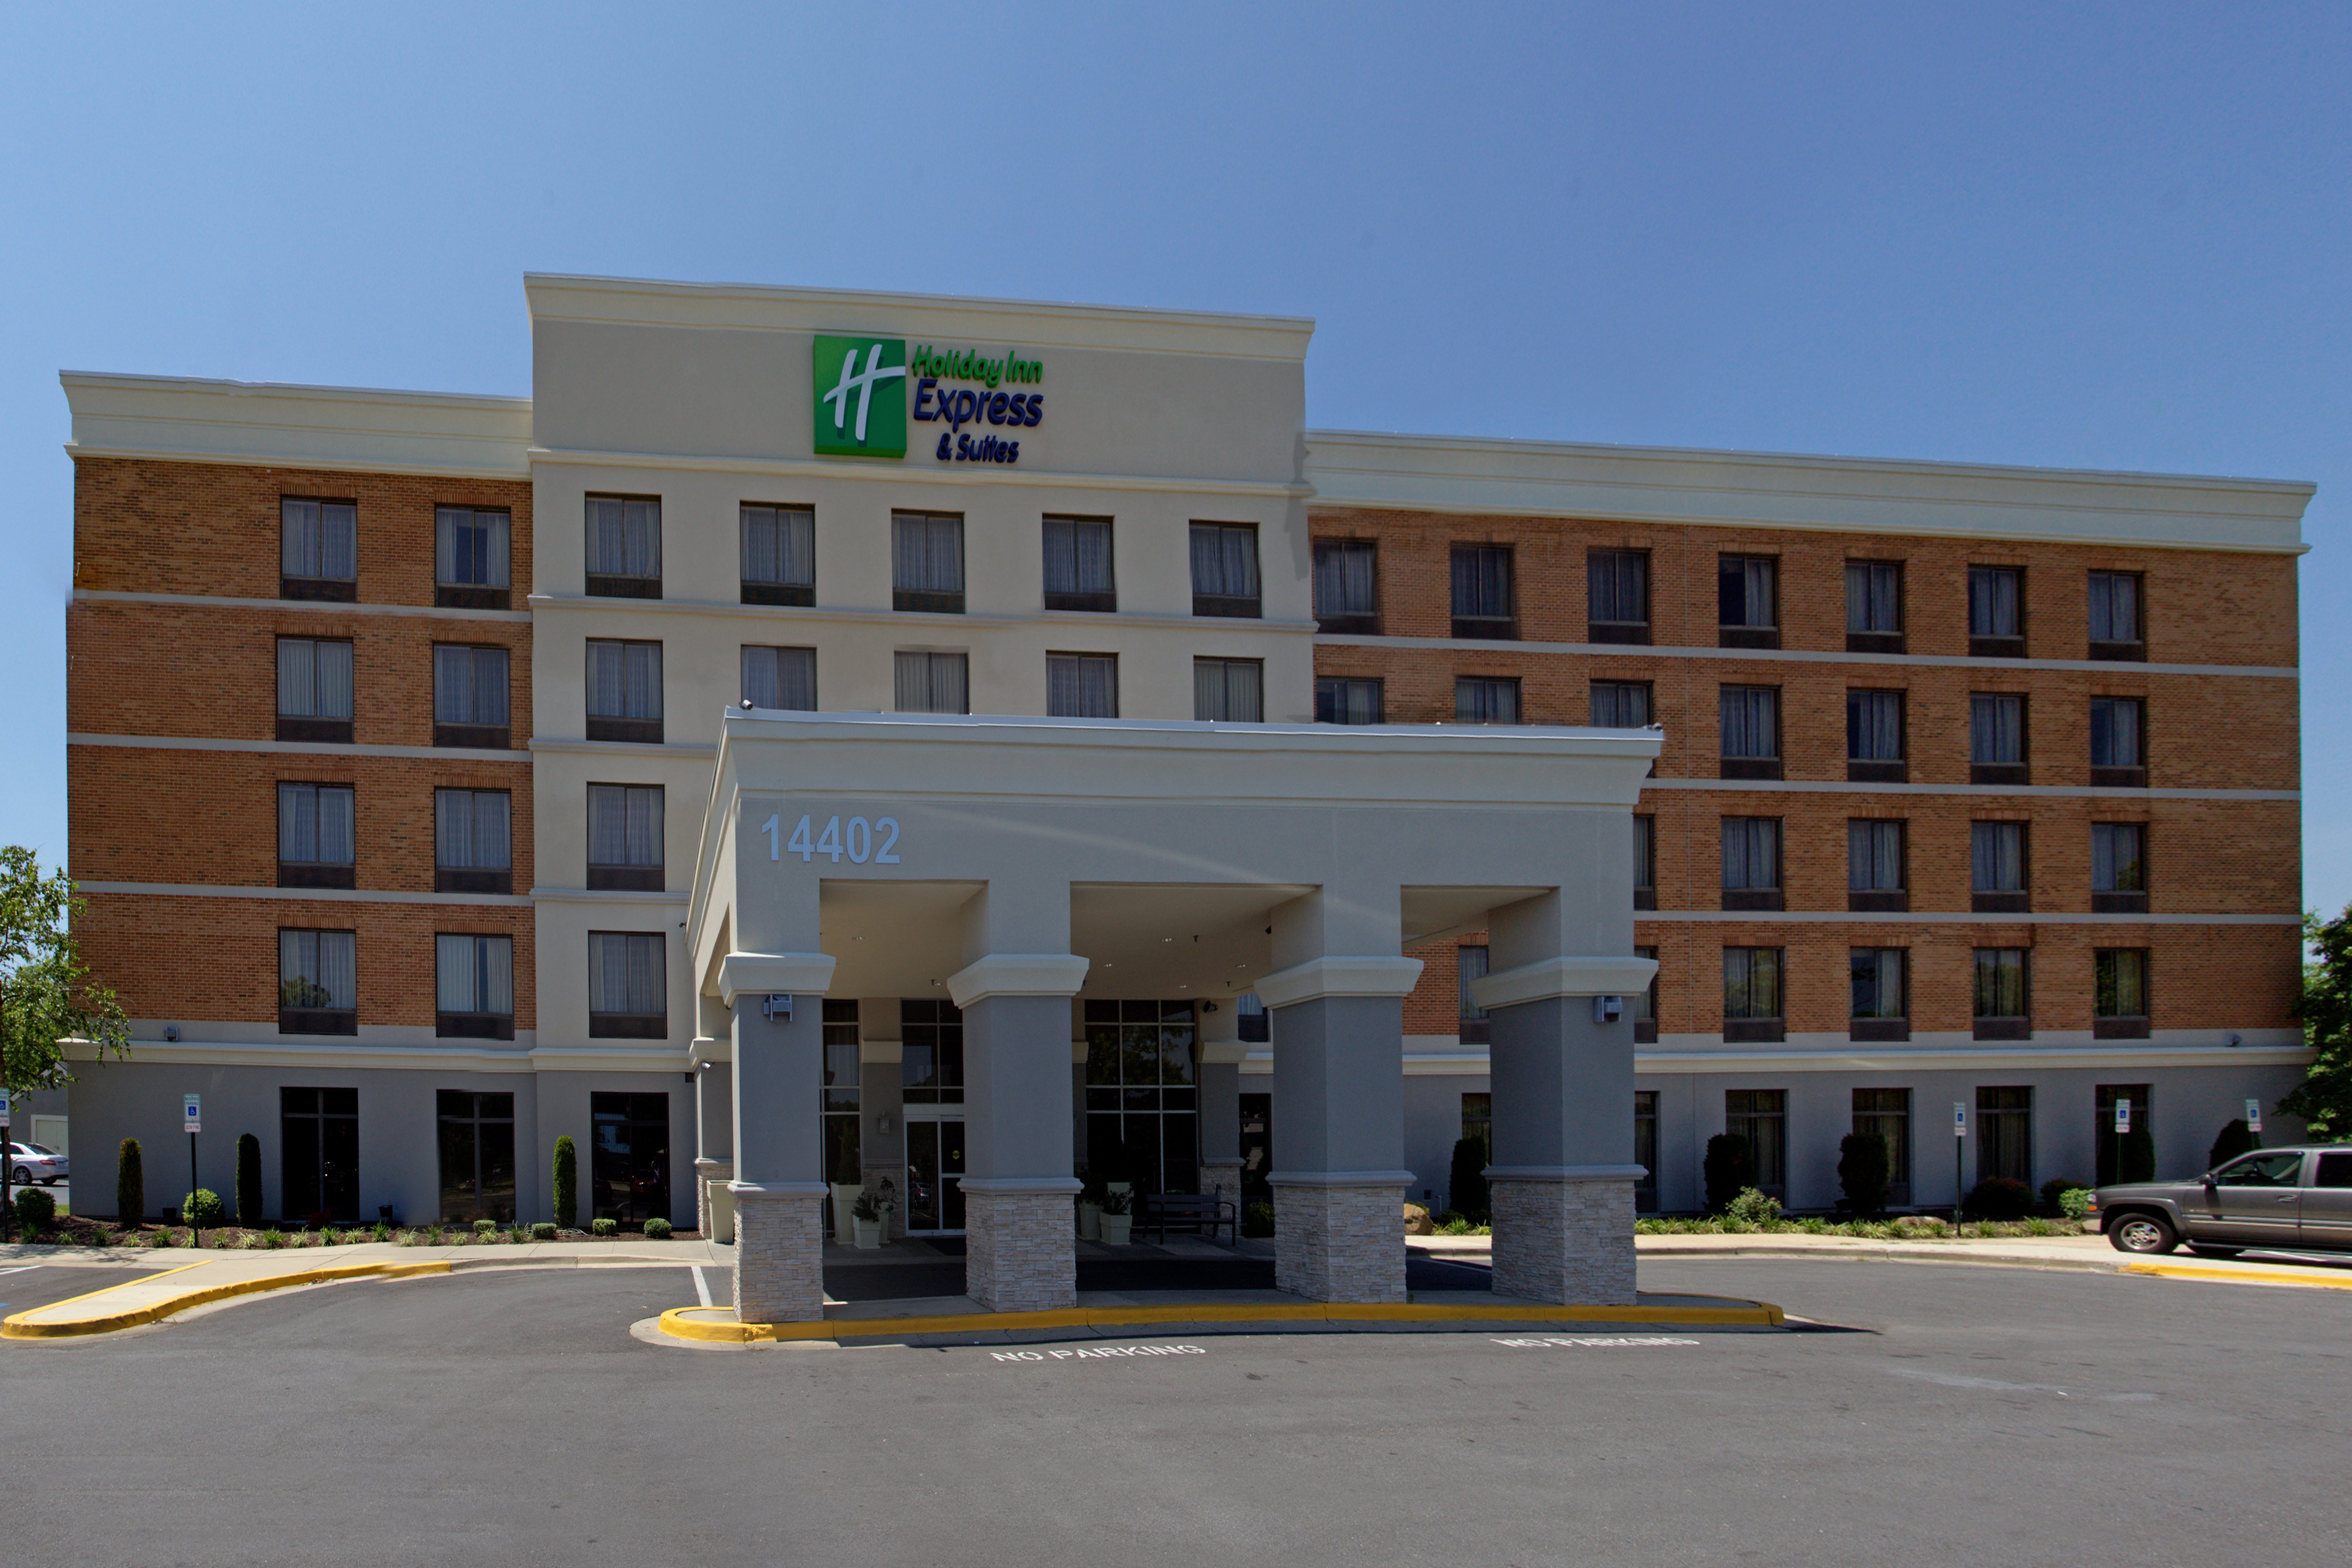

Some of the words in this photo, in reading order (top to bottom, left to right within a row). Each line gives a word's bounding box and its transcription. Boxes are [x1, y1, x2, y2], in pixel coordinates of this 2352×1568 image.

[911, 345, 1004, 388] Holiday
[1006, 350, 1043, 384] Inn
[914, 378, 1044, 434] Express
[936, 433, 953, 460] &
[955, 434, 1019, 463] Suites
[762, 813, 900, 864] 14402
[990, 1352, 1044, 1361] NO
[1048, 1345, 1206, 1359] PARKING
